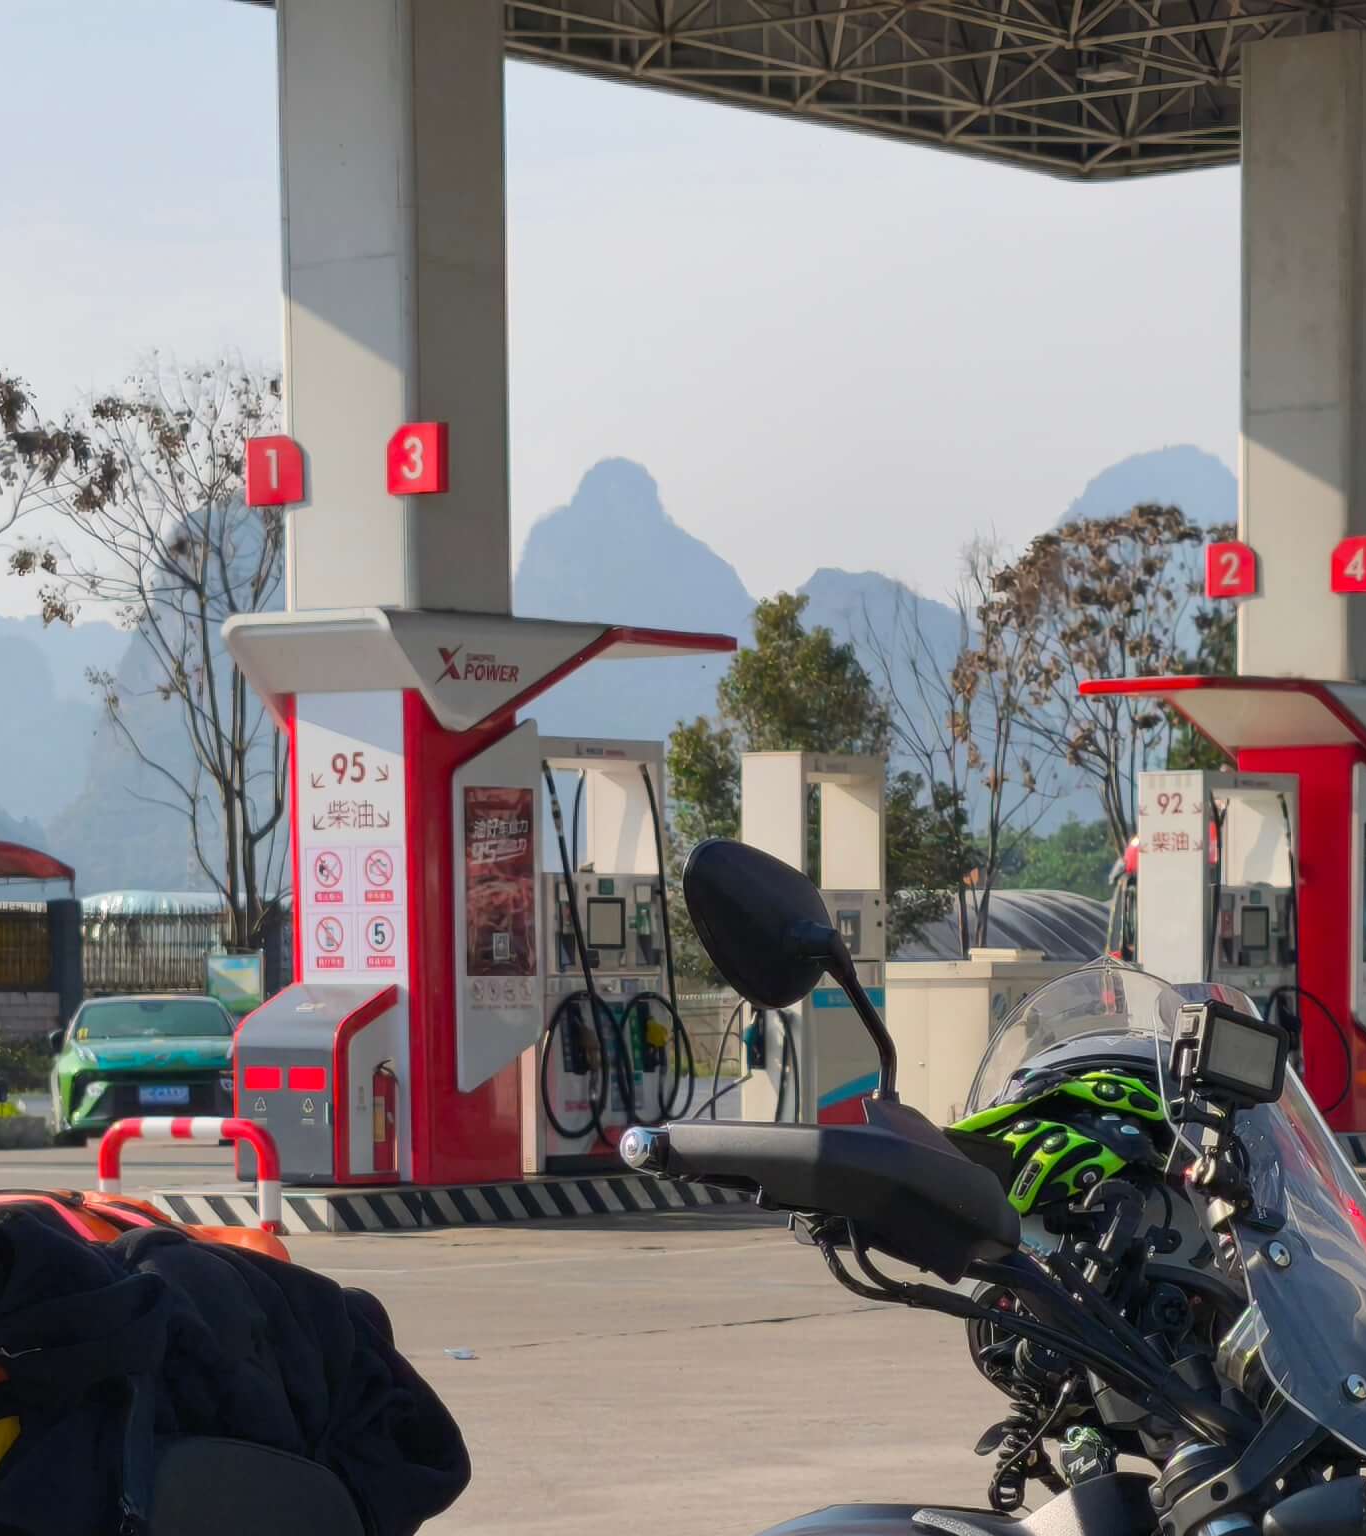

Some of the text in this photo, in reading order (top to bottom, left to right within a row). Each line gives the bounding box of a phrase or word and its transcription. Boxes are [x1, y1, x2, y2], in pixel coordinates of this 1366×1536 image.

[265, 449, 279, 489] 1
[401, 436, 424, 480] 3
[1219, 552, 1241, 585] 2
[1343, 547, 1366, 582] 4
[464, 663, 519, 682] POWER
[331, 751, 366, 784] 95
[327, 799, 374, 829] 柴油
[1156, 792, 1184, 815] 92
[1152, 831, 1190, 851] 柴油
[374, 922, 386, 945] 5
